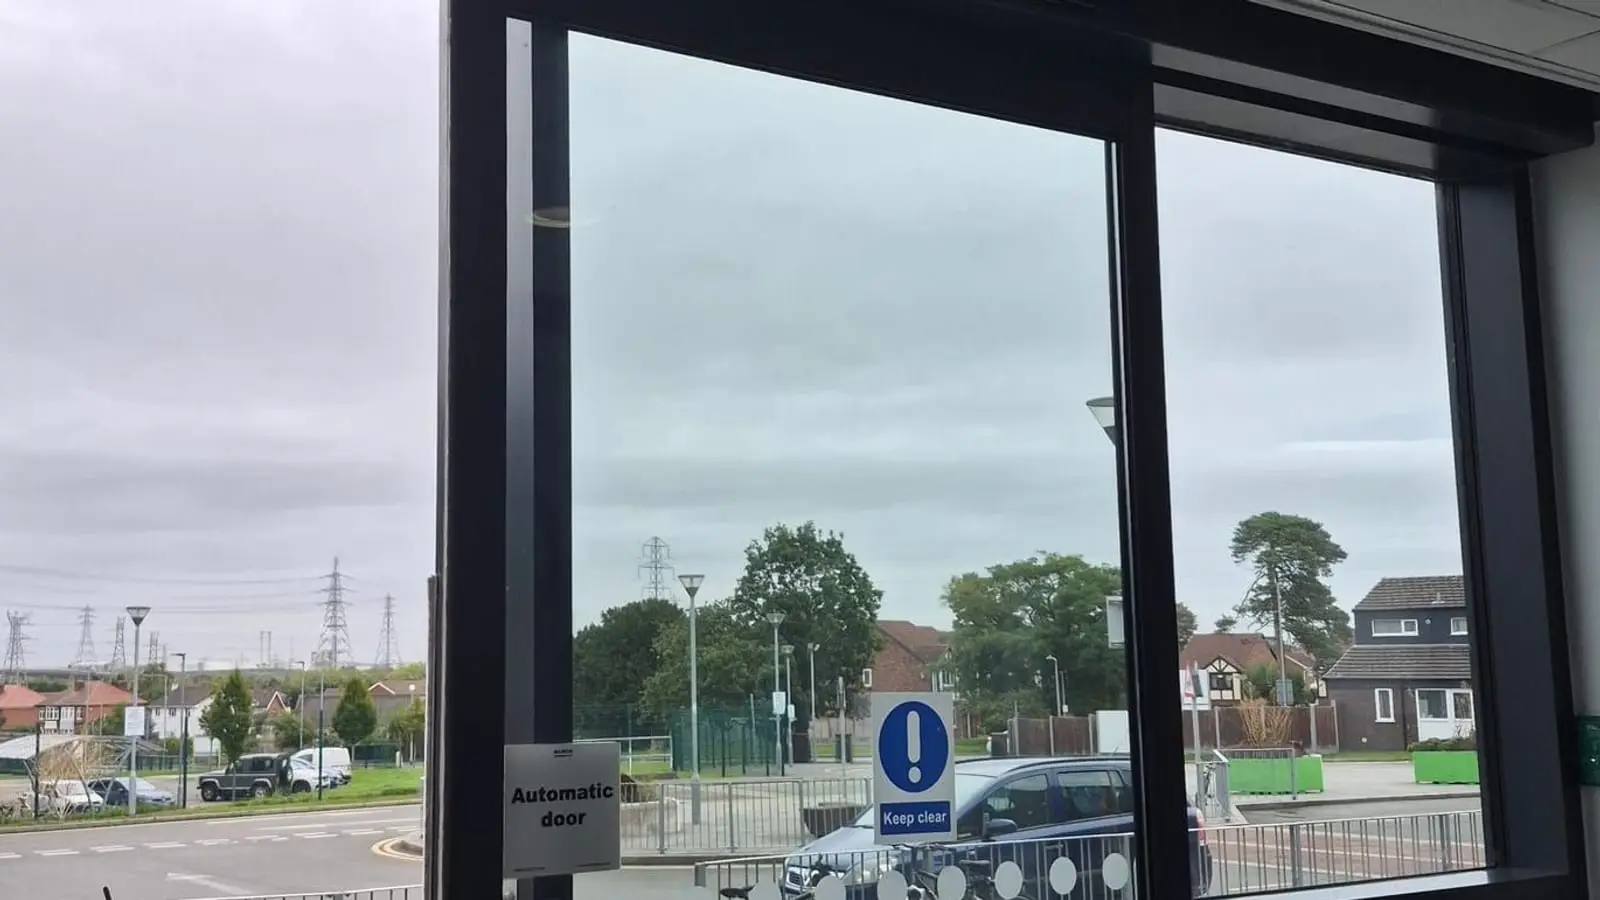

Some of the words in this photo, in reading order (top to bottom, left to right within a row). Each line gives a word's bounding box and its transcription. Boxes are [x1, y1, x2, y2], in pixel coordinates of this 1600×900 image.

[511, 783, 614, 804] Automatic
[541, 811, 587, 827] door
[883, 811, 915, 827] Keep
[917, 810, 947, 825] clear
